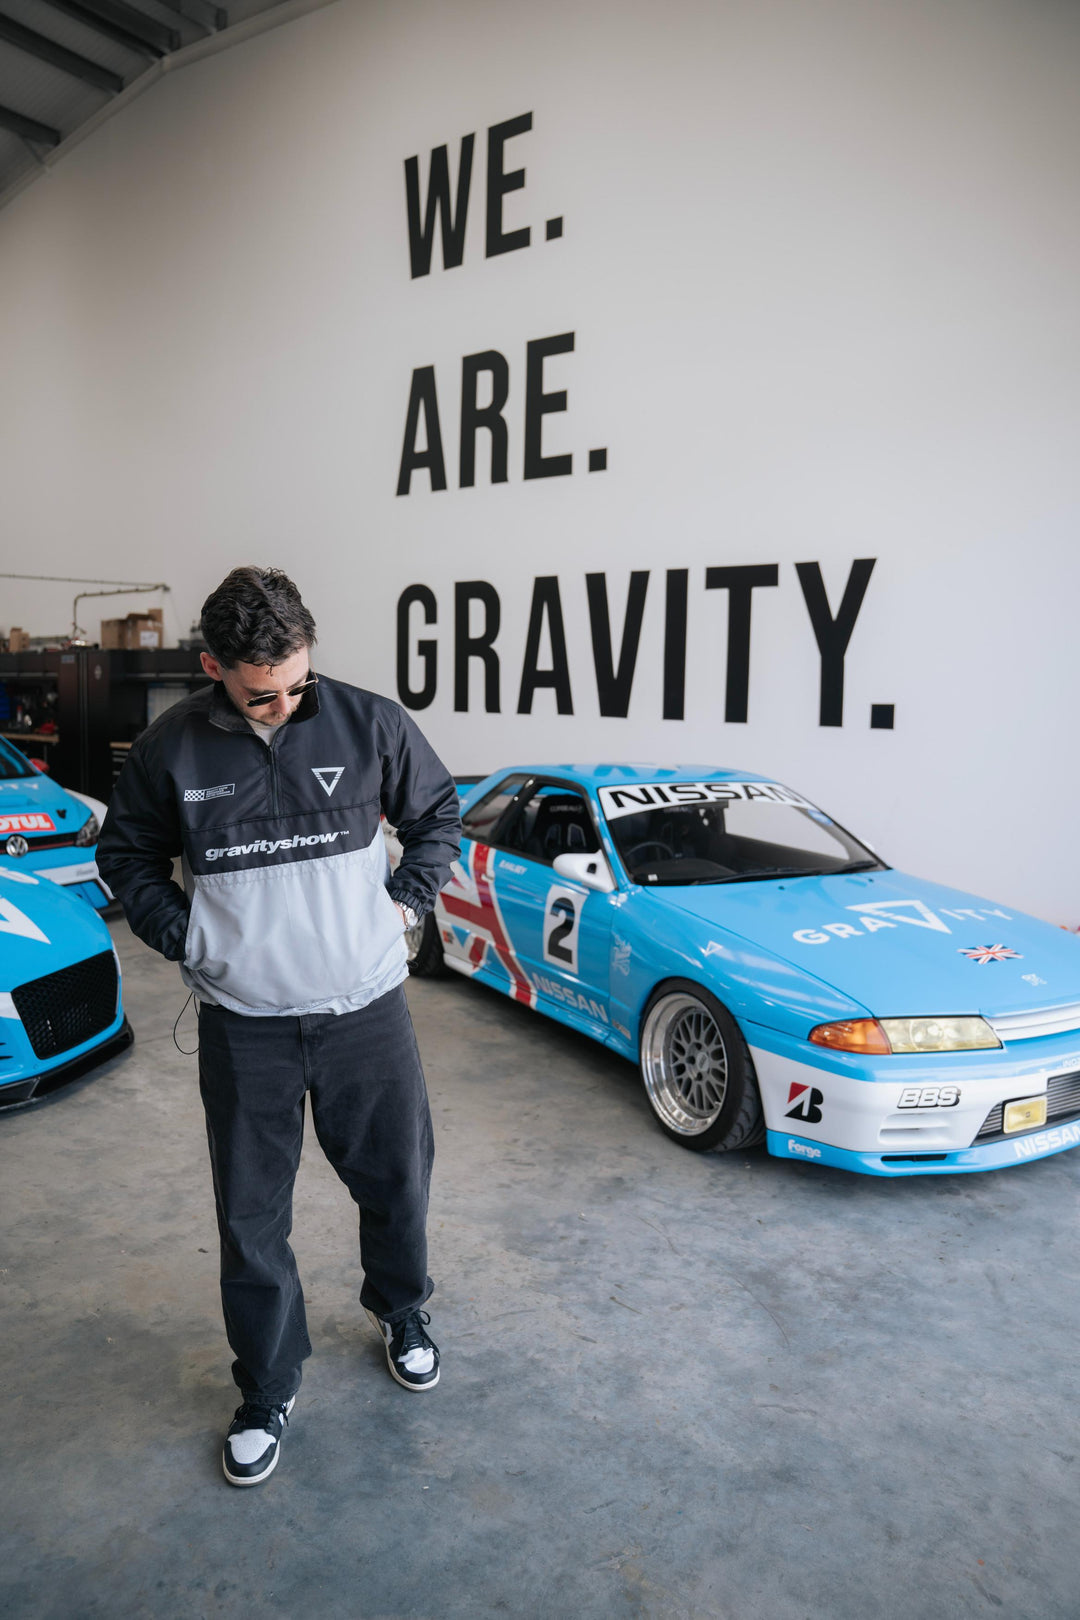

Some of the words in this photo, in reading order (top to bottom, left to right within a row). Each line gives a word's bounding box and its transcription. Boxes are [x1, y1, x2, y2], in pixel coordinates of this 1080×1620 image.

[404, 111, 563, 279] WE.
[396, 331, 607, 496] ARE.
[396, 558, 895, 729] GRAVITY.
[609, 784, 804, 808] NISSAN
[548, 897, 576, 965] 2
[532, 972, 609, 1022] NISSAN
[897, 1087, 960, 1108] BBS
